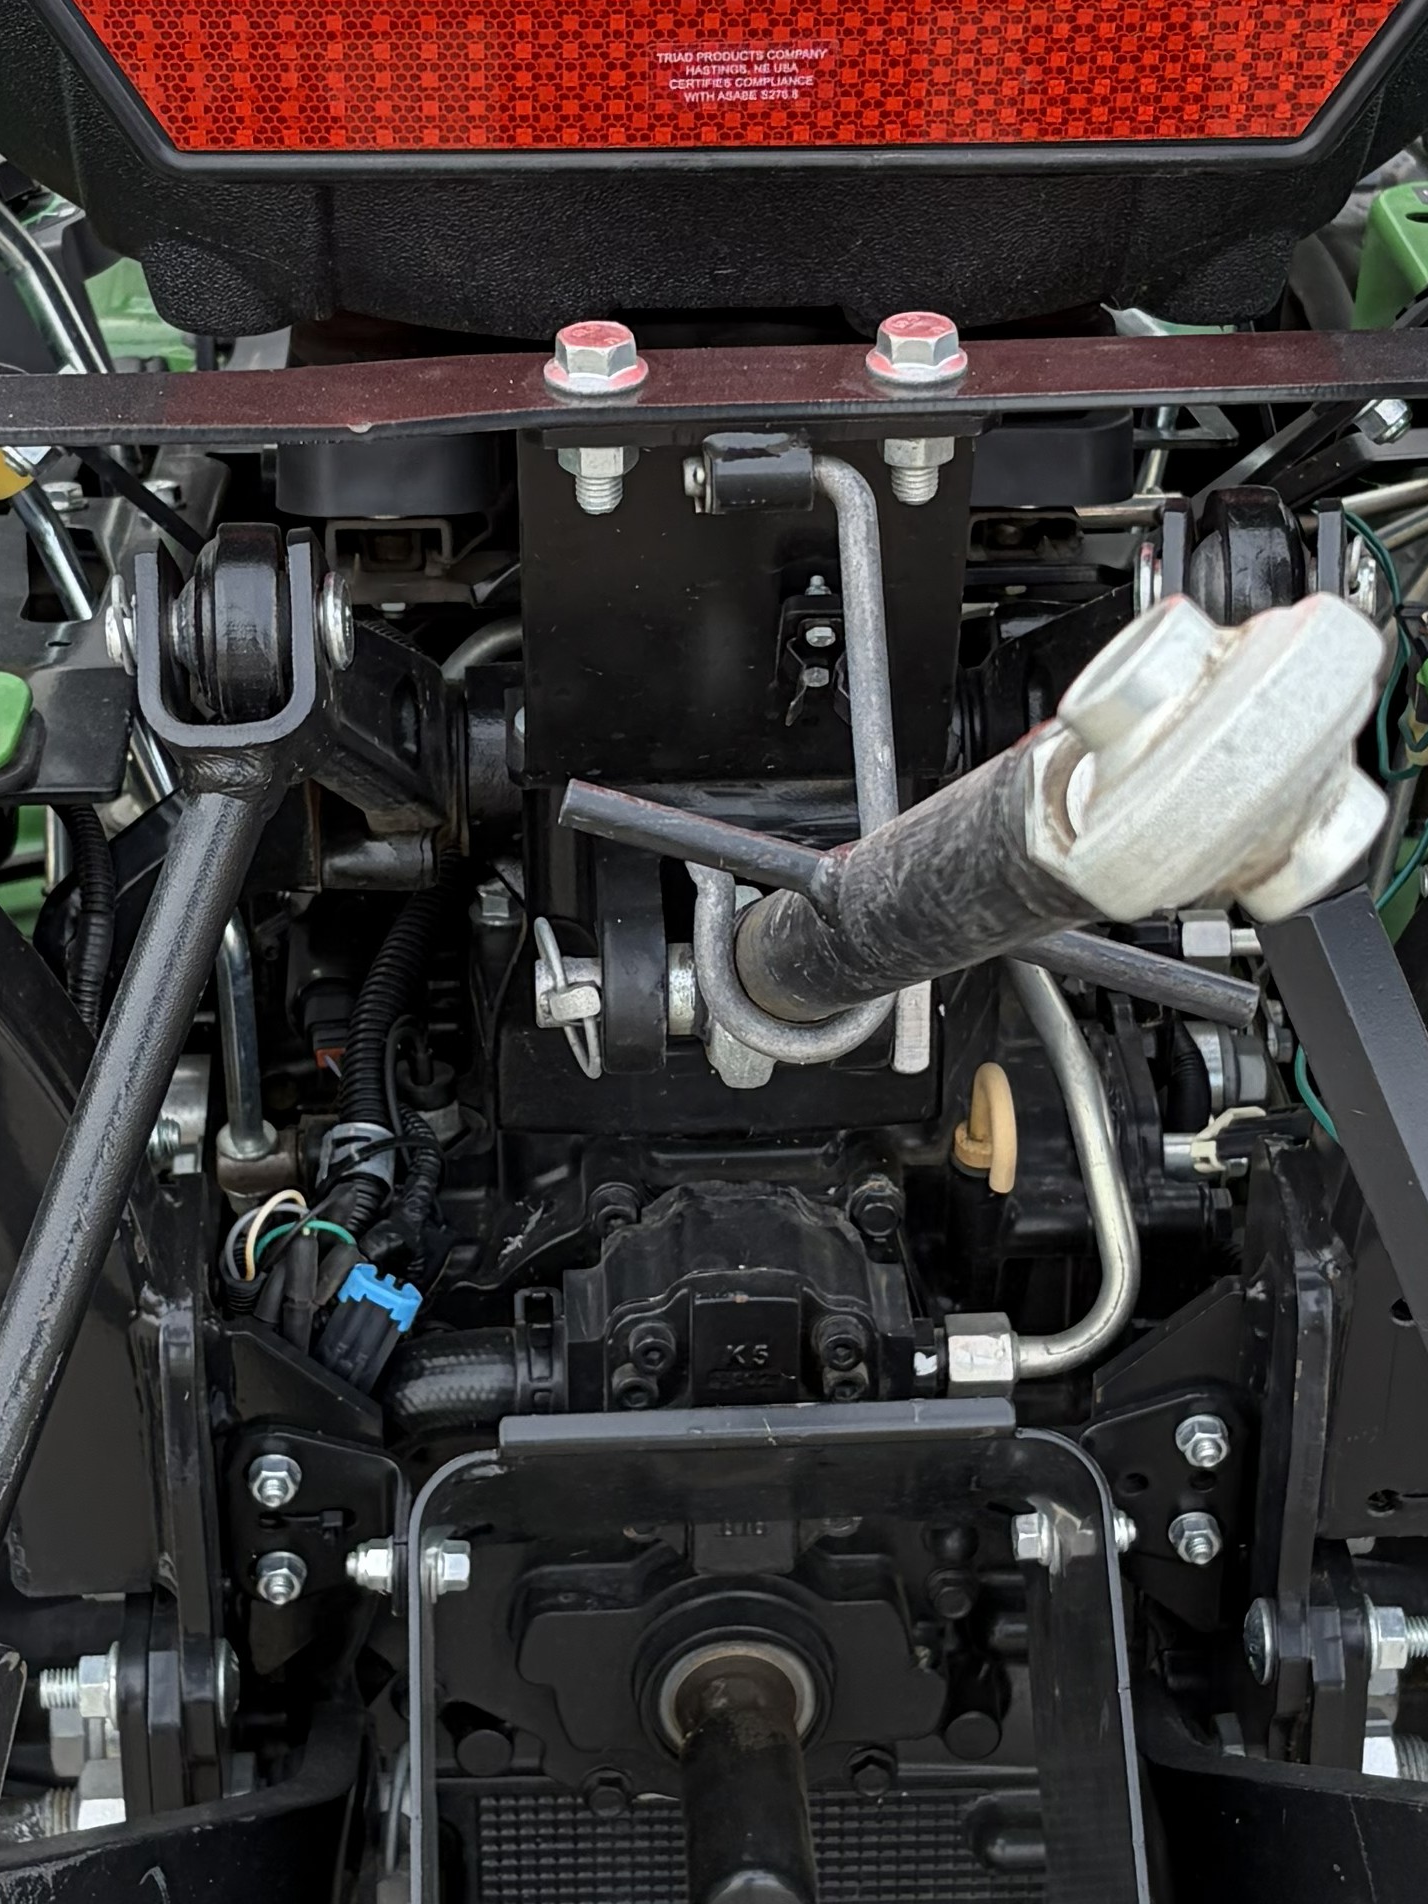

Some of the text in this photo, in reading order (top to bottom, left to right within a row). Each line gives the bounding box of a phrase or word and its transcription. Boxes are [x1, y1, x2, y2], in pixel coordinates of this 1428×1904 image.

[656, 49, 828, 63] TRIAD PRODUCTS COMPANY
[754, 64, 770, 74] NE
[773, 63, 799, 73] USA
[669, 75, 814, 90] CERTIFIES COMPLIANCE
[683, 90, 714, 103] WITH
[716, 90, 758, 101] ASABE
